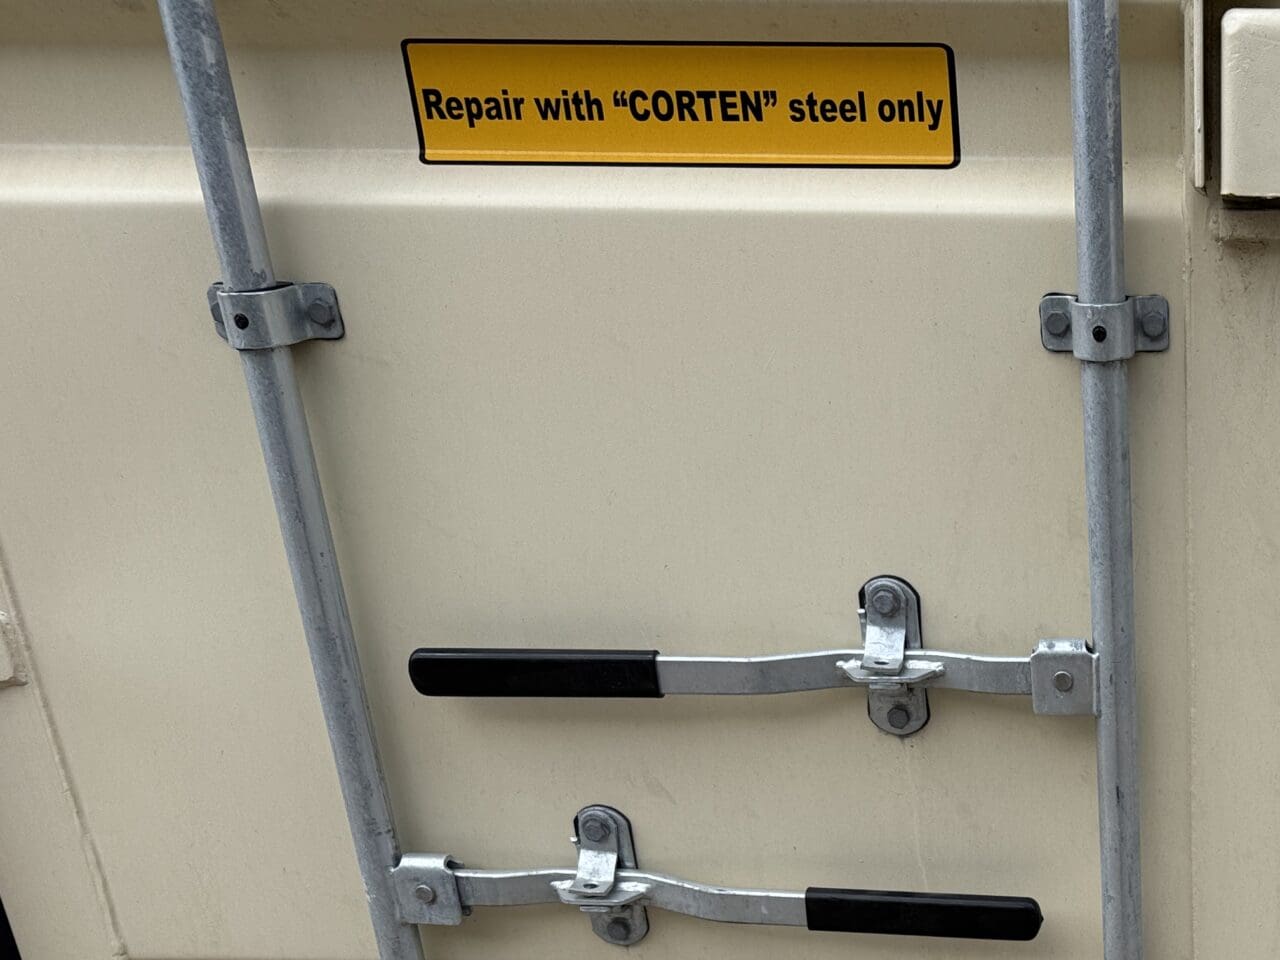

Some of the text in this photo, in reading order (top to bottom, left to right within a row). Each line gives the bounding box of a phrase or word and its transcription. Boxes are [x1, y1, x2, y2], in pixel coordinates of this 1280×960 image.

[422, 88, 524, 128] Repair
[535, 89, 604, 121] with
[790, 92, 867, 123] steel
[878, 93, 943, 131] only
